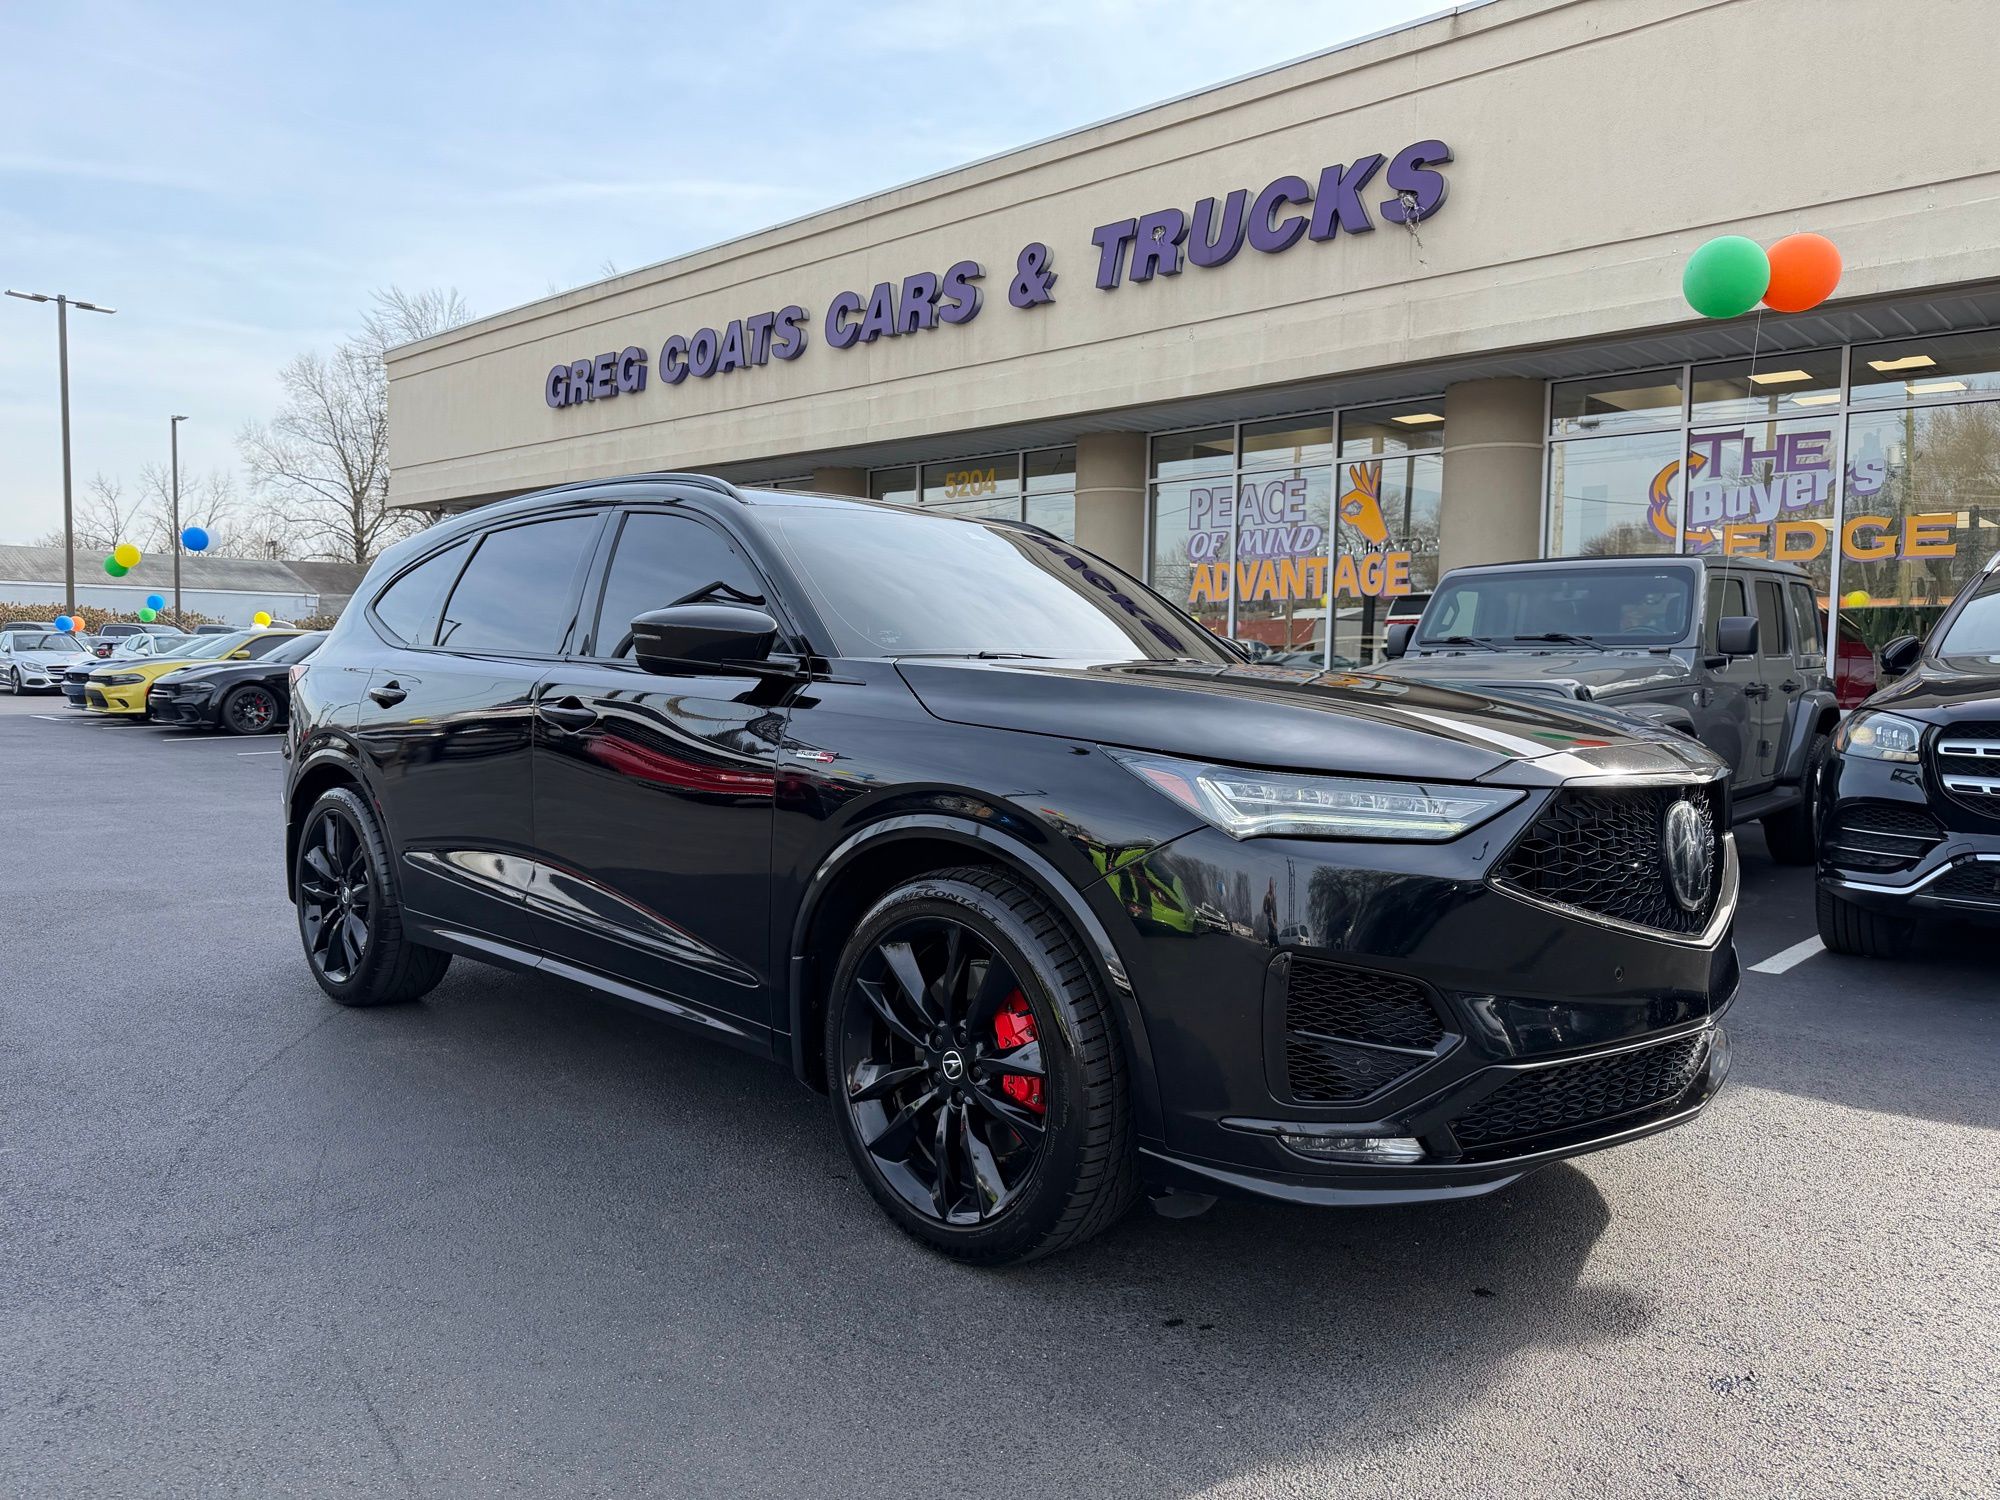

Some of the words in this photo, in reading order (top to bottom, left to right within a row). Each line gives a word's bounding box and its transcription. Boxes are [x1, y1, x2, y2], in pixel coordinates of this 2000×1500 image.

[545, 346, 648, 408] GREG
[659, 305, 811, 385] COATS
[825, 260, 986, 350] CARS
[1009, 242, 1058, 309] &
[1092, 139, 1454, 290] TRUCKS
[1690, 428, 1832, 478] THE
[944, 467, 997, 499] 5204
[1188, 478, 1308, 530] PEACE
[1187, 530, 1230, 562] OF
[1235, 524, 1323, 559] MIND
[1723, 513, 1958, 562] EDGE
[1188, 551, 1412, 604] ADVANTAGE
